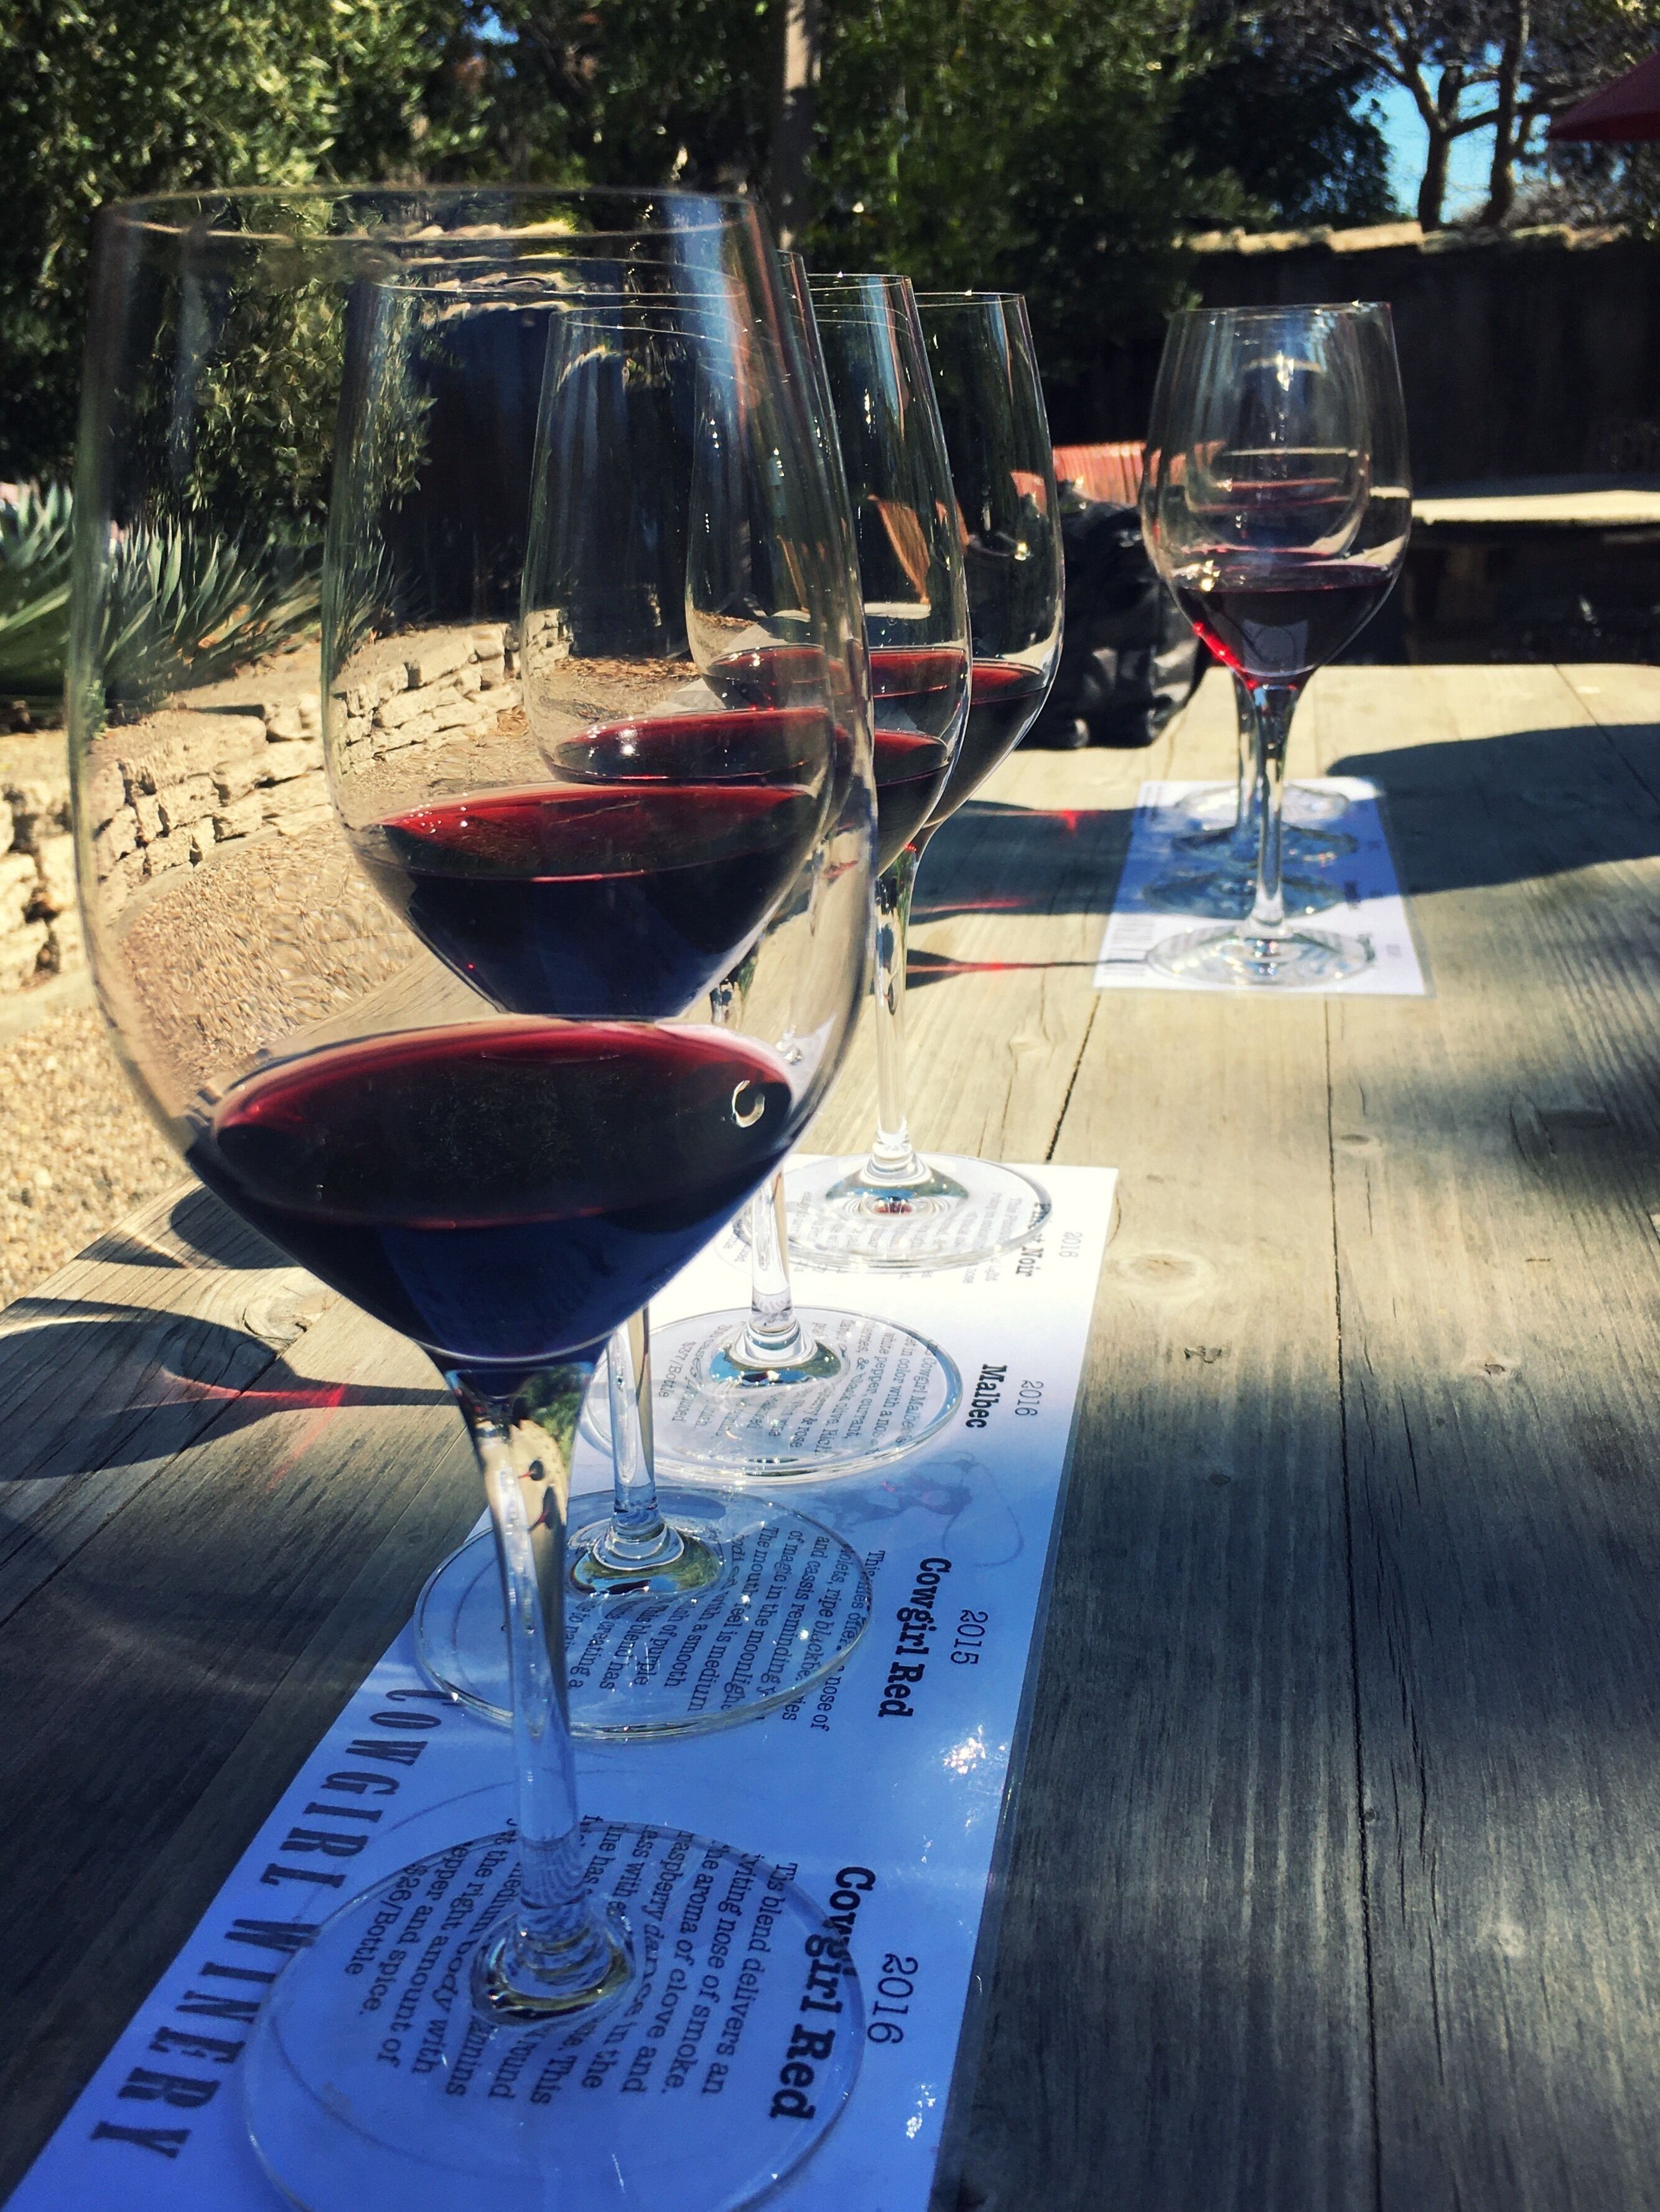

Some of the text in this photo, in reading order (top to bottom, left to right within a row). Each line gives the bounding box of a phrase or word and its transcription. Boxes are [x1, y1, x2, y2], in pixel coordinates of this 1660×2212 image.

[1016, 1247, 1044, 1276] Noir
[1059, 1231, 1083, 1258] 2016
[893, 1357, 911, 1384] color
[914, 1357, 937, 1393] Cowgirl
[883, 1385, 902, 1408] with
[966, 1364, 1007, 1428] Malbec
[1015, 1380, 1043, 1416] 2016
[790, 1426, 811, 1448] rose
[842, 1398, 872, 1439] currant,
[757, 1527, 780, 1550] The
[790, 1530, 804, 1544] of
[811, 1536, 829, 1559] and
[773, 1543, 798, 1584] magic
[795, 1560, 821, 1601] cassis
[765, 1584, 786, 1600] in
[818, 1587, 842, 1619] ripe
[658, 1624, 678, 1638] of
[692, 1624, 708, 1633] a
[755, 1603, 779, 1627] the
[569, 1620, 615, 1677] creating
[614, 1622, 651, 1657] blend
[716, 1630, 738, 1643] is
[760, 1602, 805, 1685] reminding
[877, 1557, 952, 1717] Cowgirl Red
[951, 1609, 989, 1664] 2015
[599, 1660, 625, 1689] has
[633, 1637, 671, 1686] purple
[664, 1633, 702, 1688] smooth
[687, 1645, 727, 1712] medium
[568, 1679, 584, 1689] a
[818, 1676, 842, 1712] nose
[810, 1714, 829, 1732] of
[475, 1849, 509, 1879] the
[583, 1854, 617, 1885] has
[612, 1861, 645, 1898] with
[641, 1830, 694, 1922] raspberry
[345, 1862, 429, 1976] $26/Bottle
[441, 1881, 485, 1933] right
[680, 1873, 714, 1934] aroma
[90, 1689, 460, 2159] COWGIRL WINERY
[396, 1904, 434, 1945] and
[707, 1918, 737, 1970] nose
[748, 1895, 786, 1953] blend
[674, 1938, 695, 1967] of
[359, 1948, 408, 2016] spice.
[389, 1935, 450, 2032] amount
[432, 1939, 479, 2014] body
[698, 1974, 720, 2004] of
[770, 1866, 876, 2119] Cowgirl Red
[646, 1968, 686, 2039] clove
[716, 1958, 765, 2057] delivers
[867, 1953, 918, 2044] 2016
[376, 2037, 402, 2068] of
[411, 2019, 449, 2074] with
[602, 2020, 638, 2045] in
[661, 2004, 711, 2094] smoke.
[530, 2054, 578, 2104] This
[582, 2050, 619, 2089] the
[620, 2045, 658, 2094] and
[702, 2061, 729, 2094] an
